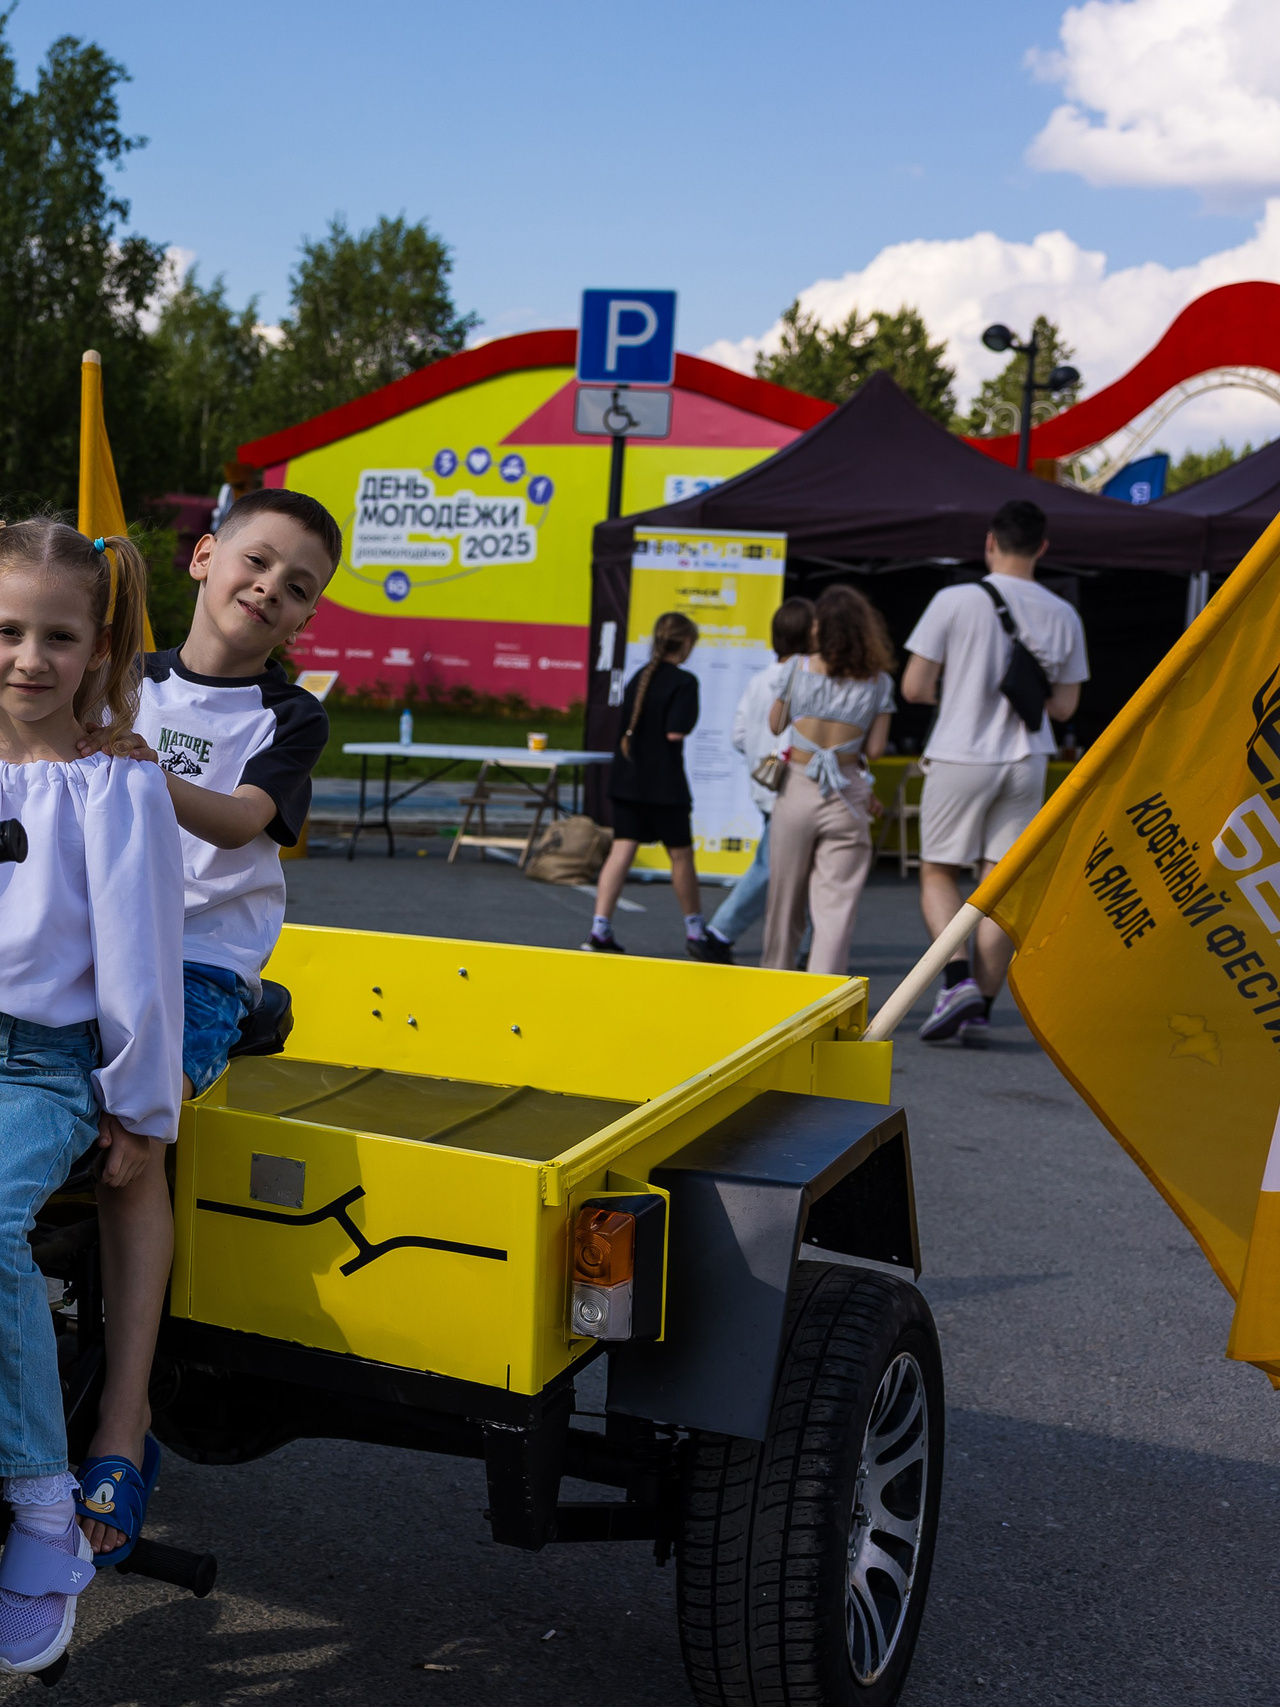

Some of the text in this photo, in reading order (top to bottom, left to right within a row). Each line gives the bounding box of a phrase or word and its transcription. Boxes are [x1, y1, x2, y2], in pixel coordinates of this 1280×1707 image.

[604, 299, 658, 372] P
[361, 475, 429, 501] ДЕНЬ
[358, 498, 520, 530] МОЛОДЁЖИ
[465, 533, 531, 559] 2025
[156, 727, 214, 764] NATURE
[1125, 791, 1232, 928] КОФЕЙНЫЙ
[1088, 864, 1157, 949] ЯМАЛЕ
